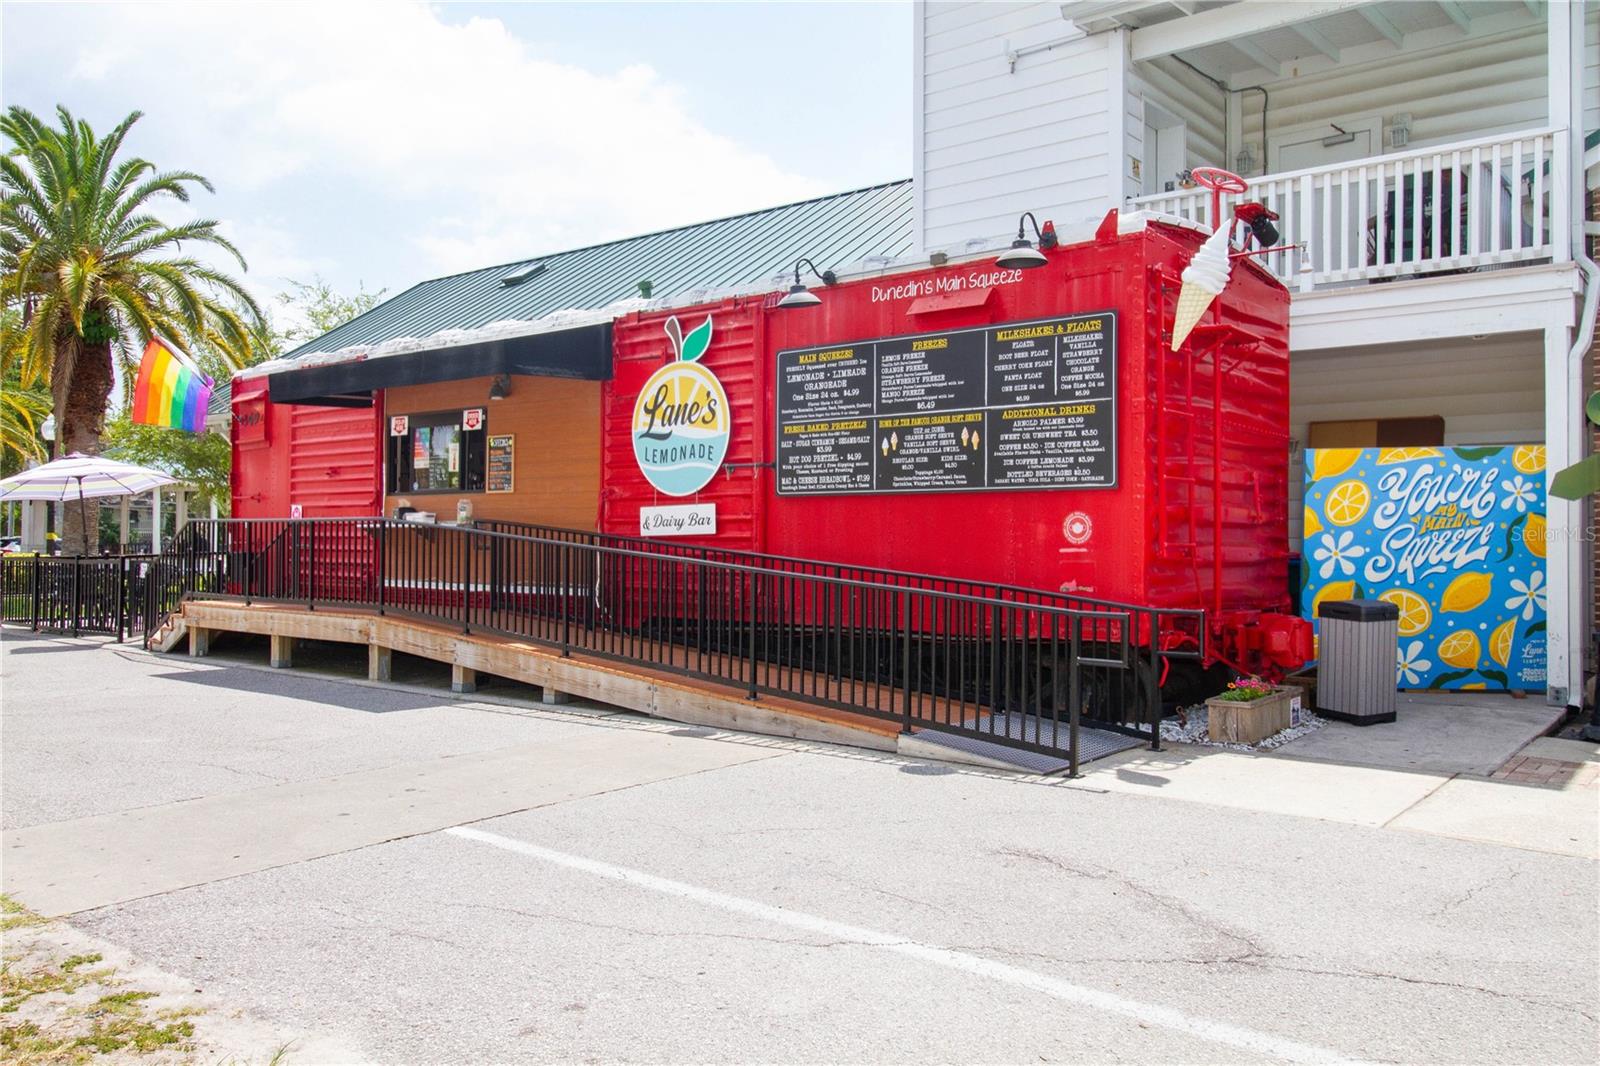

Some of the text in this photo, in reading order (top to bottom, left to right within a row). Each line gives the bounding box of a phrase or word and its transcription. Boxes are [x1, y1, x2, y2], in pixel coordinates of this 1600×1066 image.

[872, 268, 1024, 303] Dunedin's Main Squeeze
[997, 320, 1102, 342] MILKSHAKES & FLOATS
[912, 338, 948, 351] FREEZES
[1069, 341, 1097, 350] VANILLA
[799, 349, 854, 364] MAIN SQUEEZES
[1030, 350, 1048, 358] FLOAT
[1062, 348, 1103, 359] STRAWBERRY
[1035, 360, 1053, 368] FLOAT
[1065, 357, 1100, 366] CHOCOLATE
[881, 366, 904, 374] ORANGE
[1070, 365, 1095, 373] ORANGE
[787, 368, 867, 383] LEMONADE LIMEADE
[1024, 372, 1042, 380] FLOAT
[1060, 374, 1083, 382] COFFEE
[804, 380, 847, 391] ORANGEADE
[881, 377, 920, 387] STRAWBERRY
[792, 393, 804, 401] One
[805, 392, 819, 400] Size
[844, 389, 860, 397] $4.99
[916, 401, 936, 410] $6.49
[638, 384, 717, 441] Lane's
[1002, 404, 1096, 420] ADDITIONAL DRINKS
[807, 423, 829, 433] BAKED
[831, 420, 867, 431] PRETZELS
[1013, 419, 1039, 427] ARNOLD
[1040, 418, 1066, 426] PALMER
[644, 443, 714, 465] LEMONADE
[1040, 457, 1074, 465] LEMONADE
[1373, 463, 1500, 530] You're
[643, 512, 712, 532] & Dairy Bar
[1365, 522, 1495, 585] Squeeze
